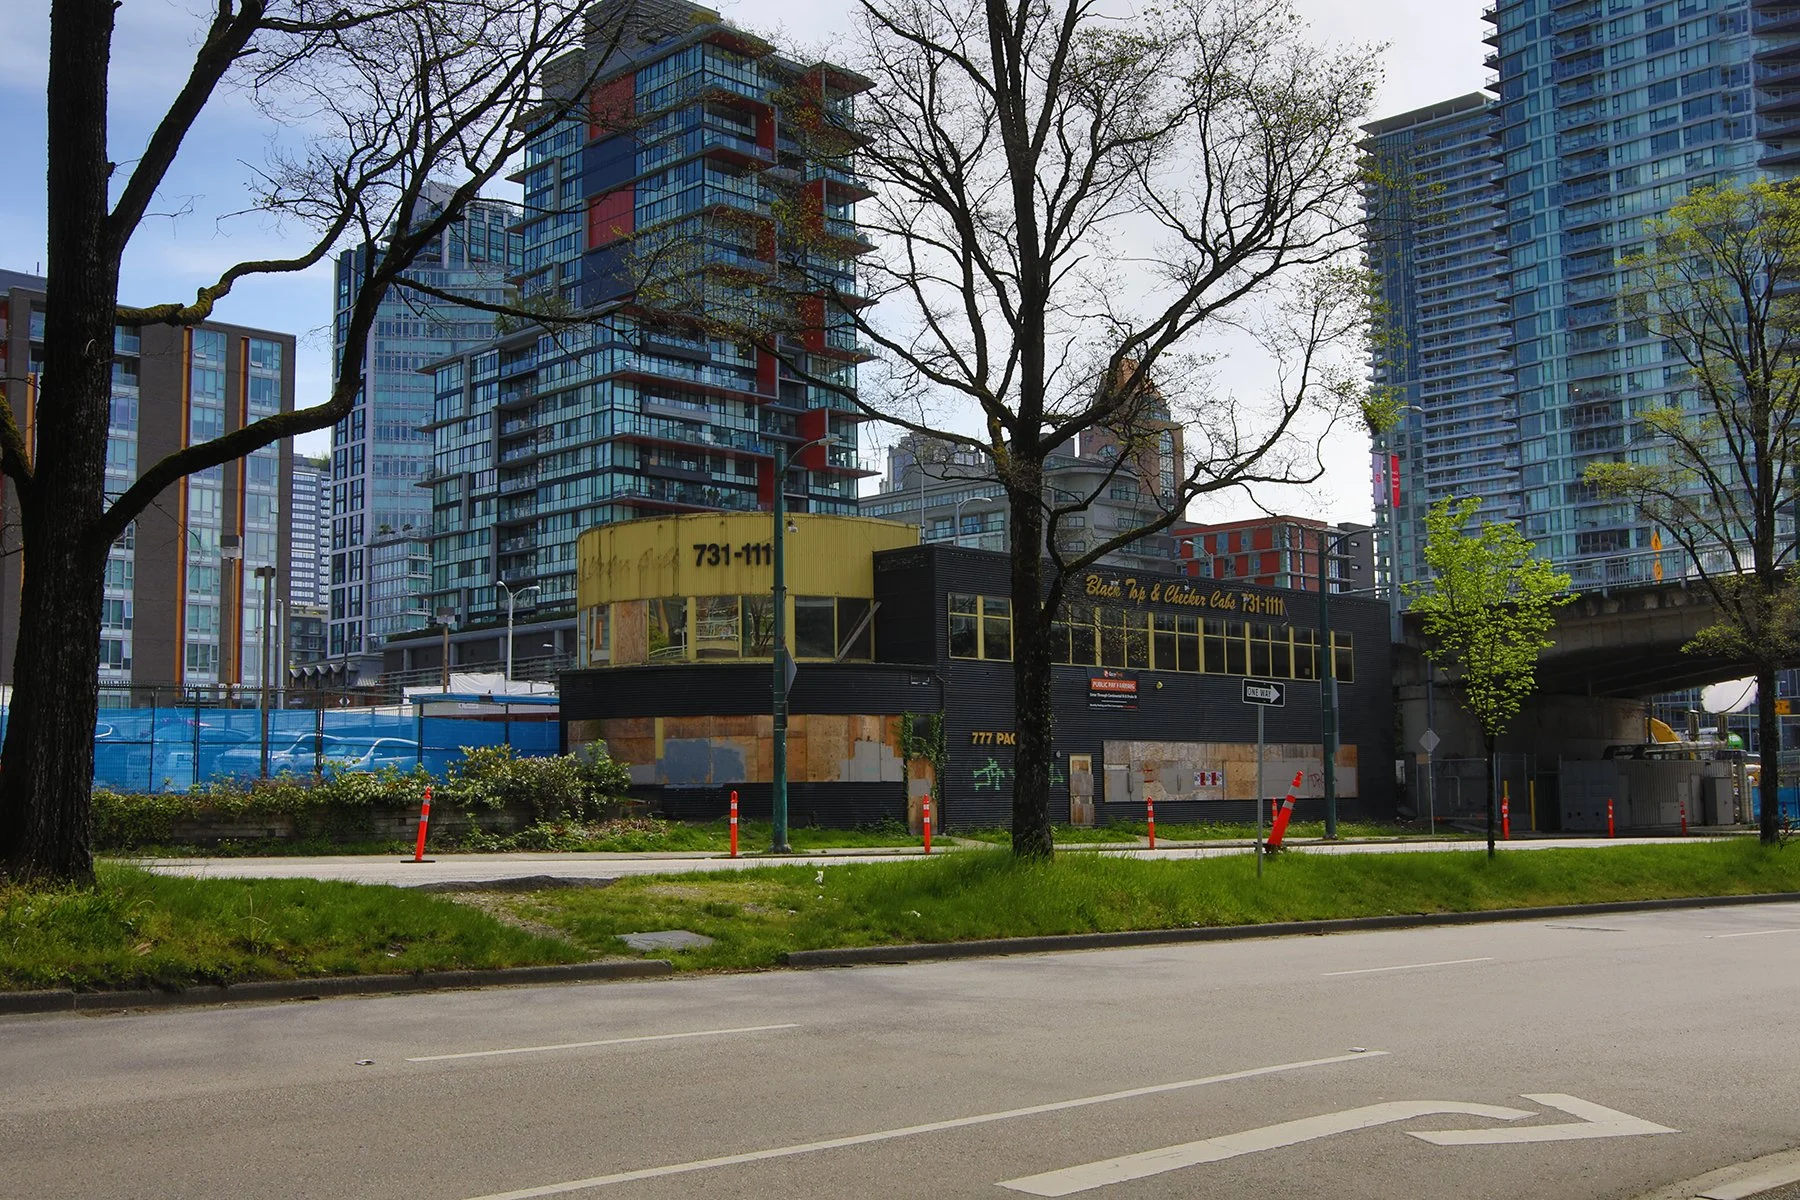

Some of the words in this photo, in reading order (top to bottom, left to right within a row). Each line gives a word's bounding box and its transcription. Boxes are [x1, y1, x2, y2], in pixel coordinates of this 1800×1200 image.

[693, 543, 774, 567] 731-111
[1086, 575, 1121, 598] Black
[1125, 578, 1147, 605] Top
[1151, 583, 1161, 601] &
[1164, 585, 1206, 607] Checker
[1210, 590, 1237, 610] Cabs
[1241, 592, 1284, 616] 731-1111
[1248, 687, 1259, 697] ONE
[1260, 689, 1271, 698] WAY
[972, 732, 993, 745] 777
